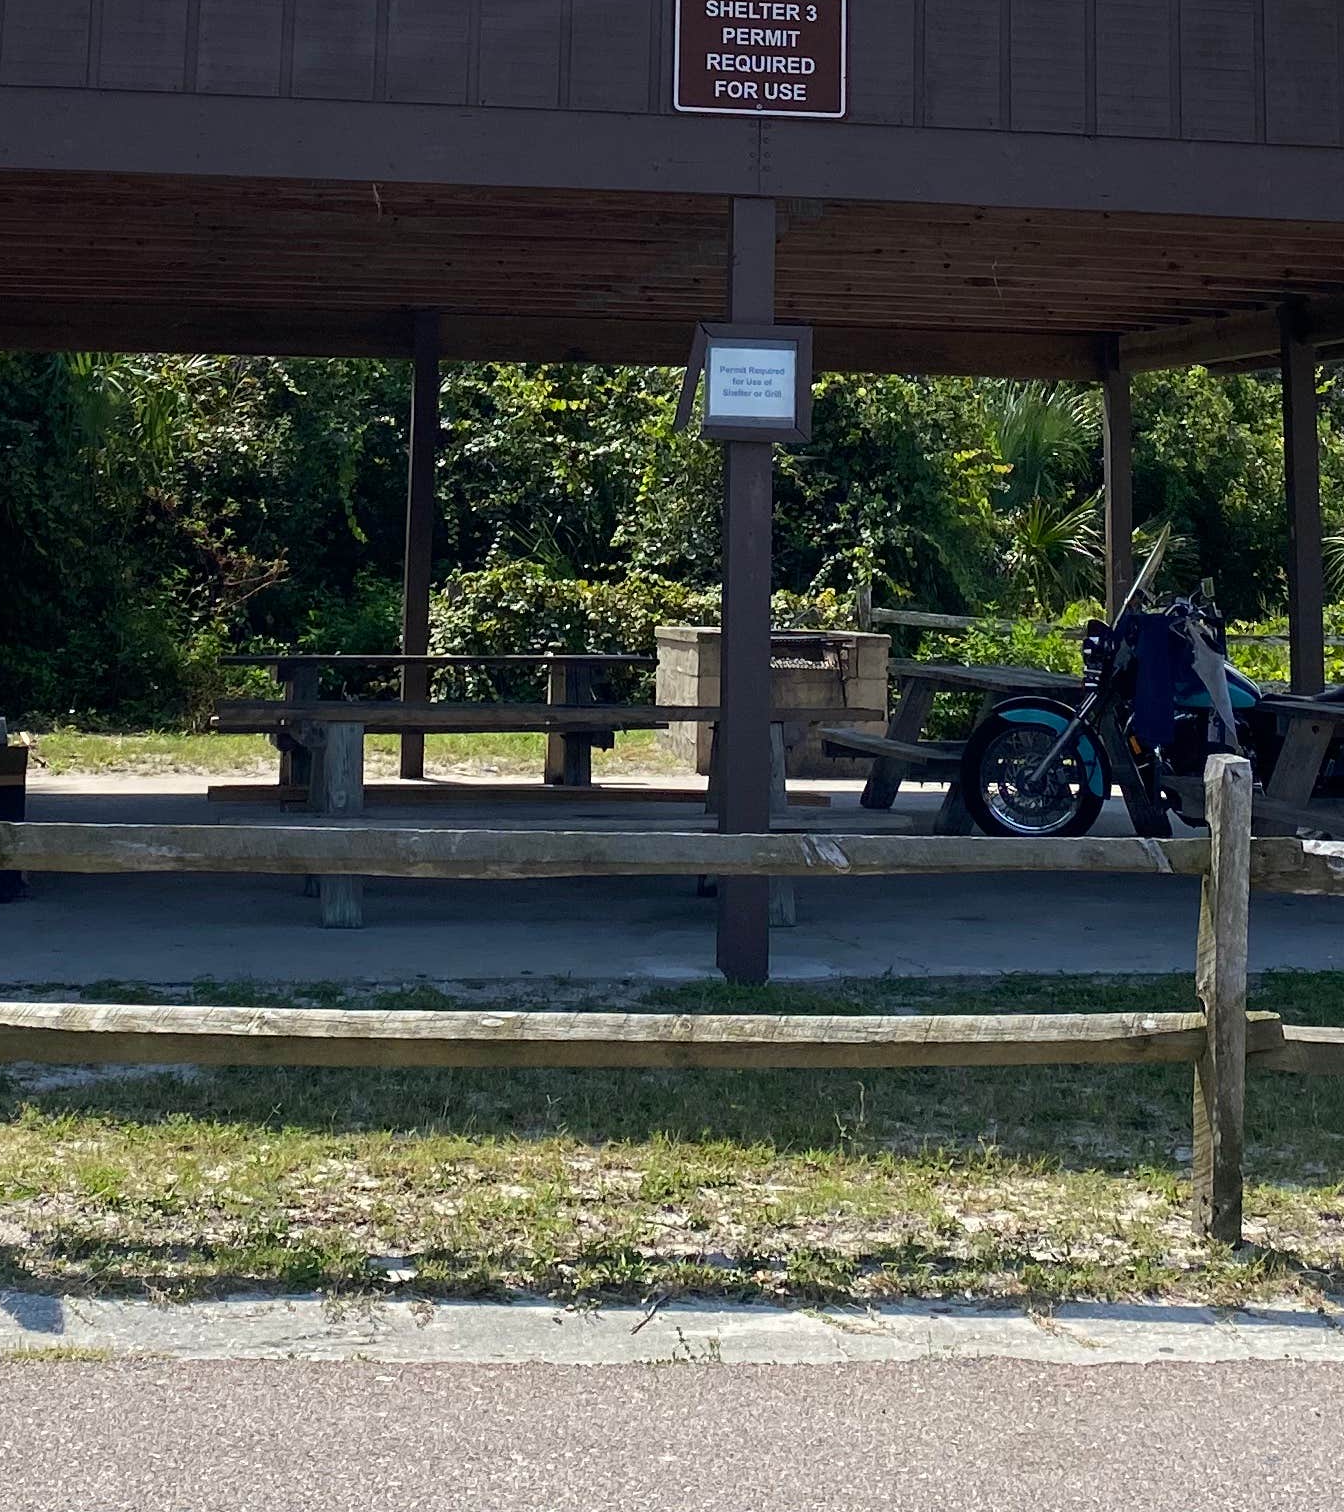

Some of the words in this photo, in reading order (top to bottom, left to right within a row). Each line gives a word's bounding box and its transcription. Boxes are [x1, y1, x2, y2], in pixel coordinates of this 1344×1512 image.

[705, 0, 801, 21] SHELTER
[806, 5, 817, 22] 3
[722, 27, 801, 48] PERMIT
[706, 53, 815, 74] REQUIRED
[714, 80, 758, 99] FOR
[764, 83, 807, 101] USE
[719, 365, 747, 374] Permit
[748, 366, 785, 376] Required
[732, 377, 744, 386] for
[746, 378, 761, 386] Use
[764, 378, 773, 386] of
[722, 389, 753, 398] Shelter
[754, 390, 762, 398] or
[764, 390, 782, 398] Grill
